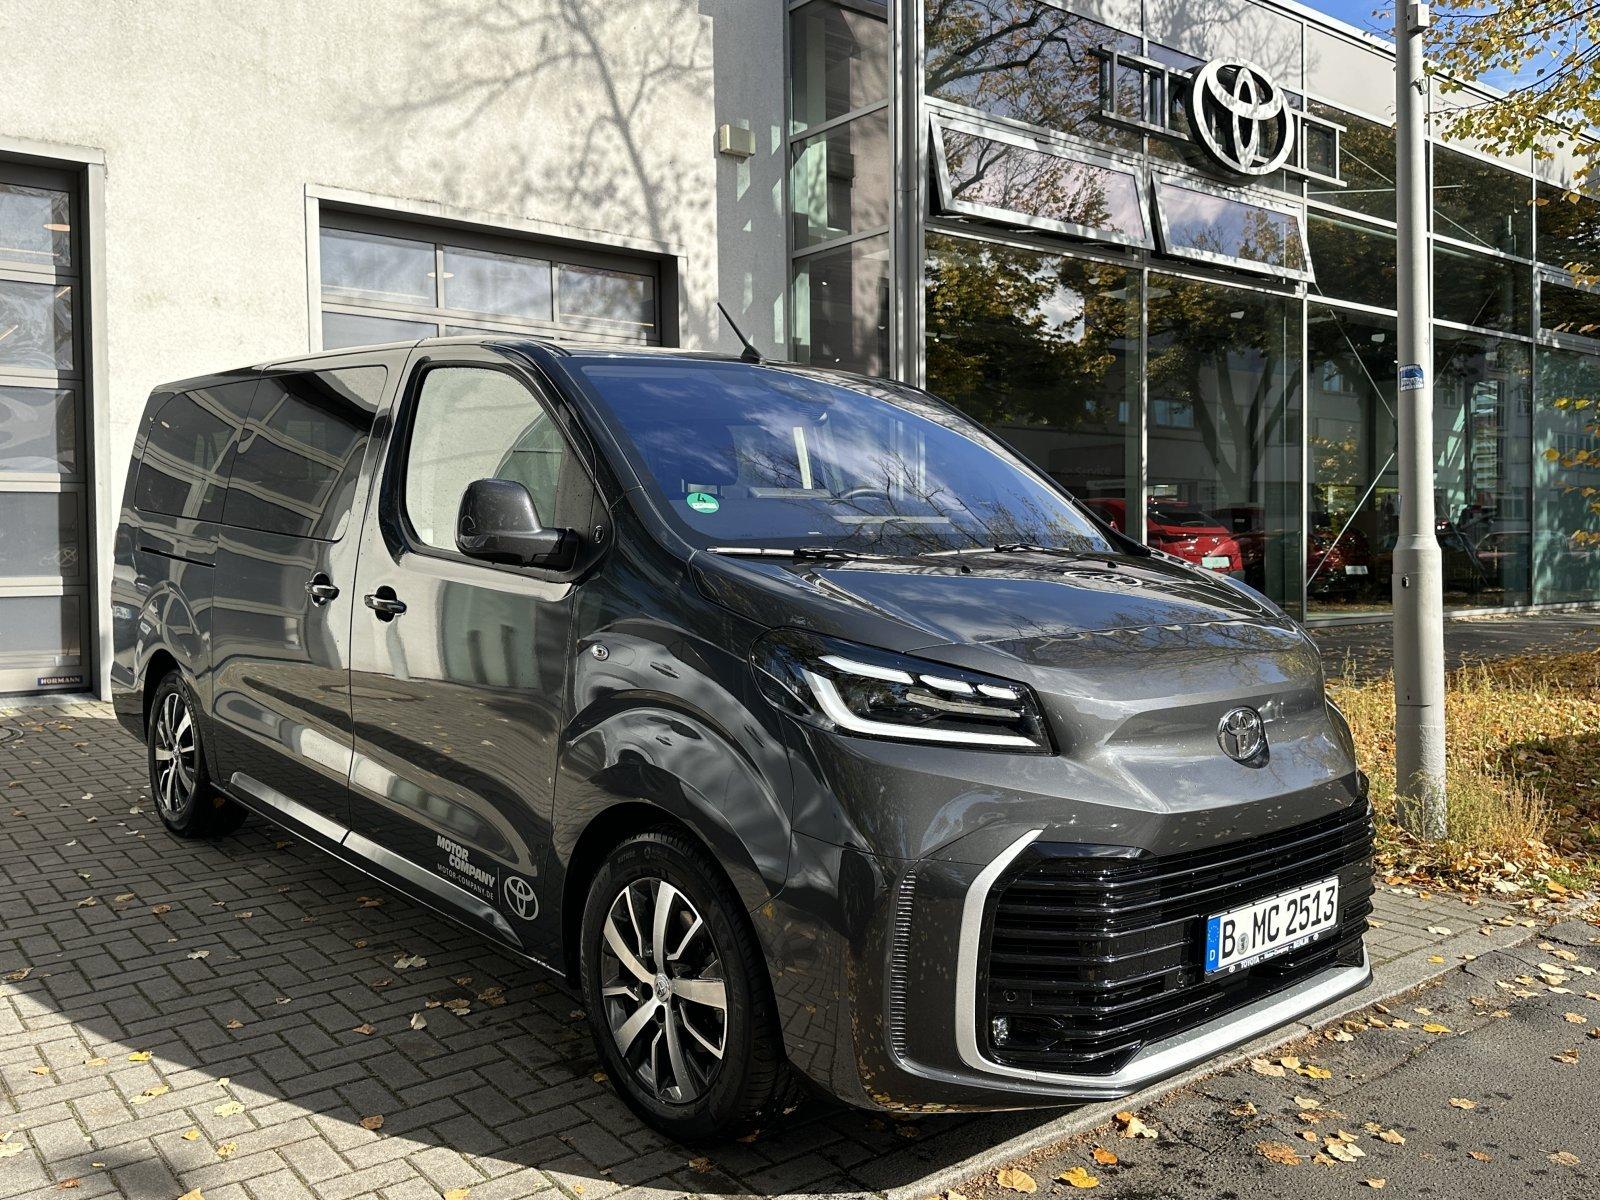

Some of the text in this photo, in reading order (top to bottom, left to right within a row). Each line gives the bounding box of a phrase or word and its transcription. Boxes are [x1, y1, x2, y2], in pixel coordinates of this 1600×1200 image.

[697, 493, 706, 503] 4
[436, 834, 469, 861] MOTOR
[437, 863, 494, 900] MOTOR-COMPANY.DE
[449, 854, 495, 887] COMPANY
[1221, 885, 1335, 960] B MC 2513
[1209, 949, 1216, 961] D
[1240, 955, 1260, 968] TOYOTA
